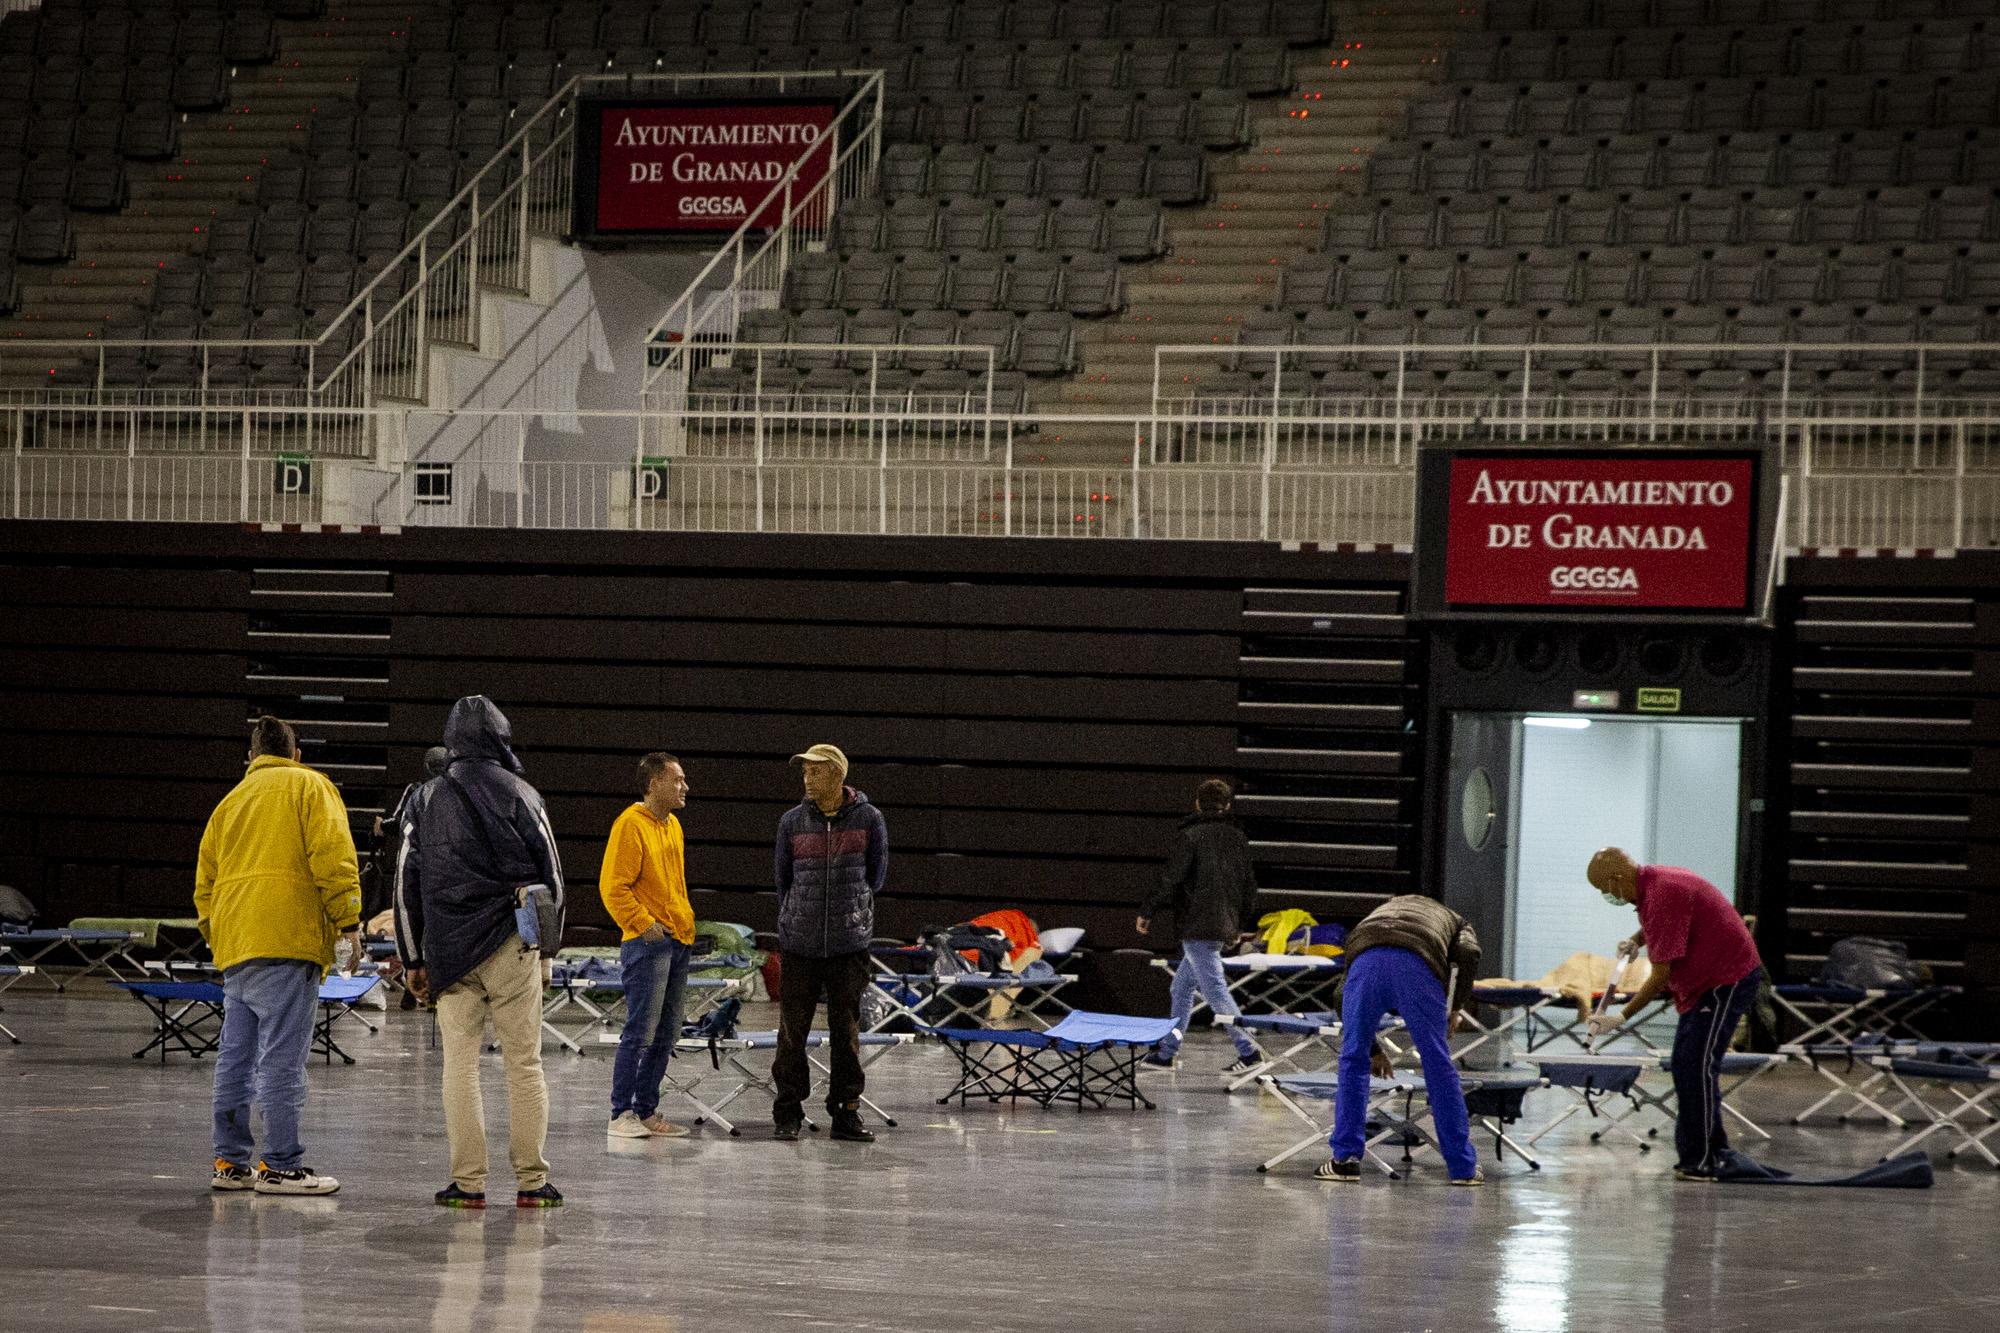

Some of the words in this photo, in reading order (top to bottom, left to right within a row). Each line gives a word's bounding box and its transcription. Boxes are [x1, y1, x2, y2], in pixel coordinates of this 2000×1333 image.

[615, 117, 819, 146] AYUNTAMIENTO
[629, 162, 664, 182] DE
[283, 465, 302, 491] D
[641, 470, 660, 497] D
[1468, 468, 1733, 505] AYUNTAMIENTO
[1487, 524, 1532, 548] DE
[1542, 513, 1707, 550] GRANADA
[1642, 695, 1675, 704] SALIDA
